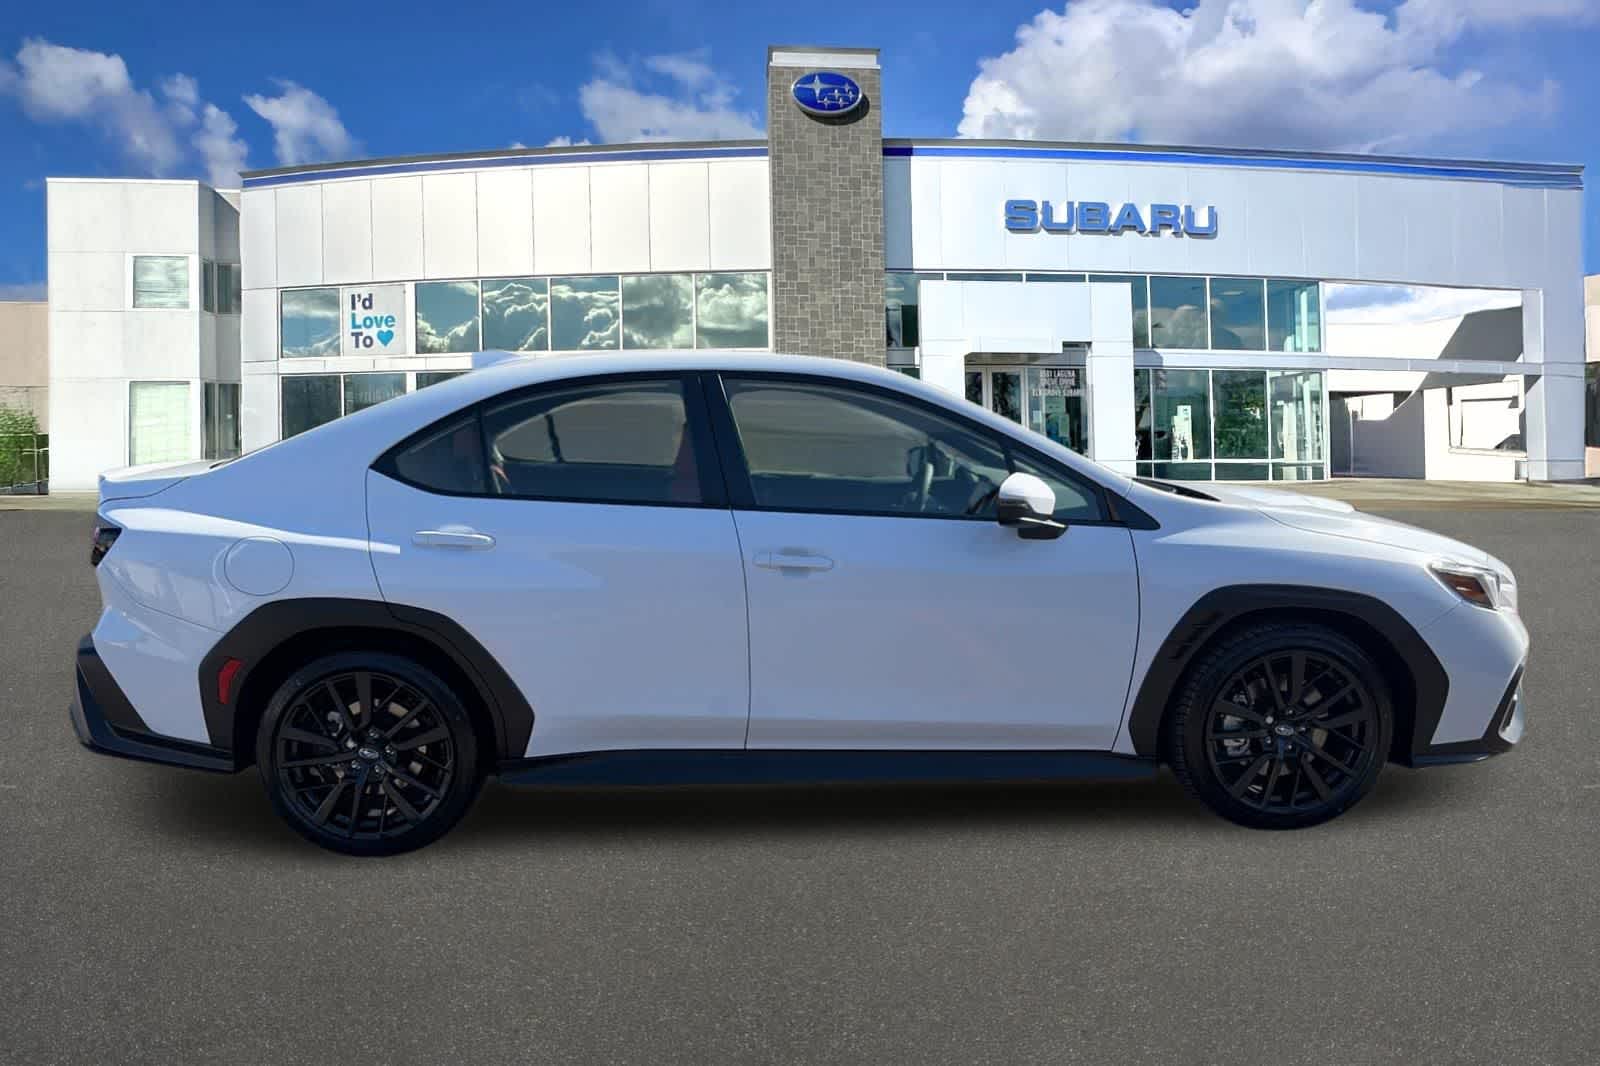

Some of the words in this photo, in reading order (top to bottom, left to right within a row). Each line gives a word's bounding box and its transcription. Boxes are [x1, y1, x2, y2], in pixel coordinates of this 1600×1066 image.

[1005, 200, 1218, 238] SUBARU
[351, 293, 373, 310] I'd
[351, 312, 396, 329] Love
[351, 332, 374, 348] To
